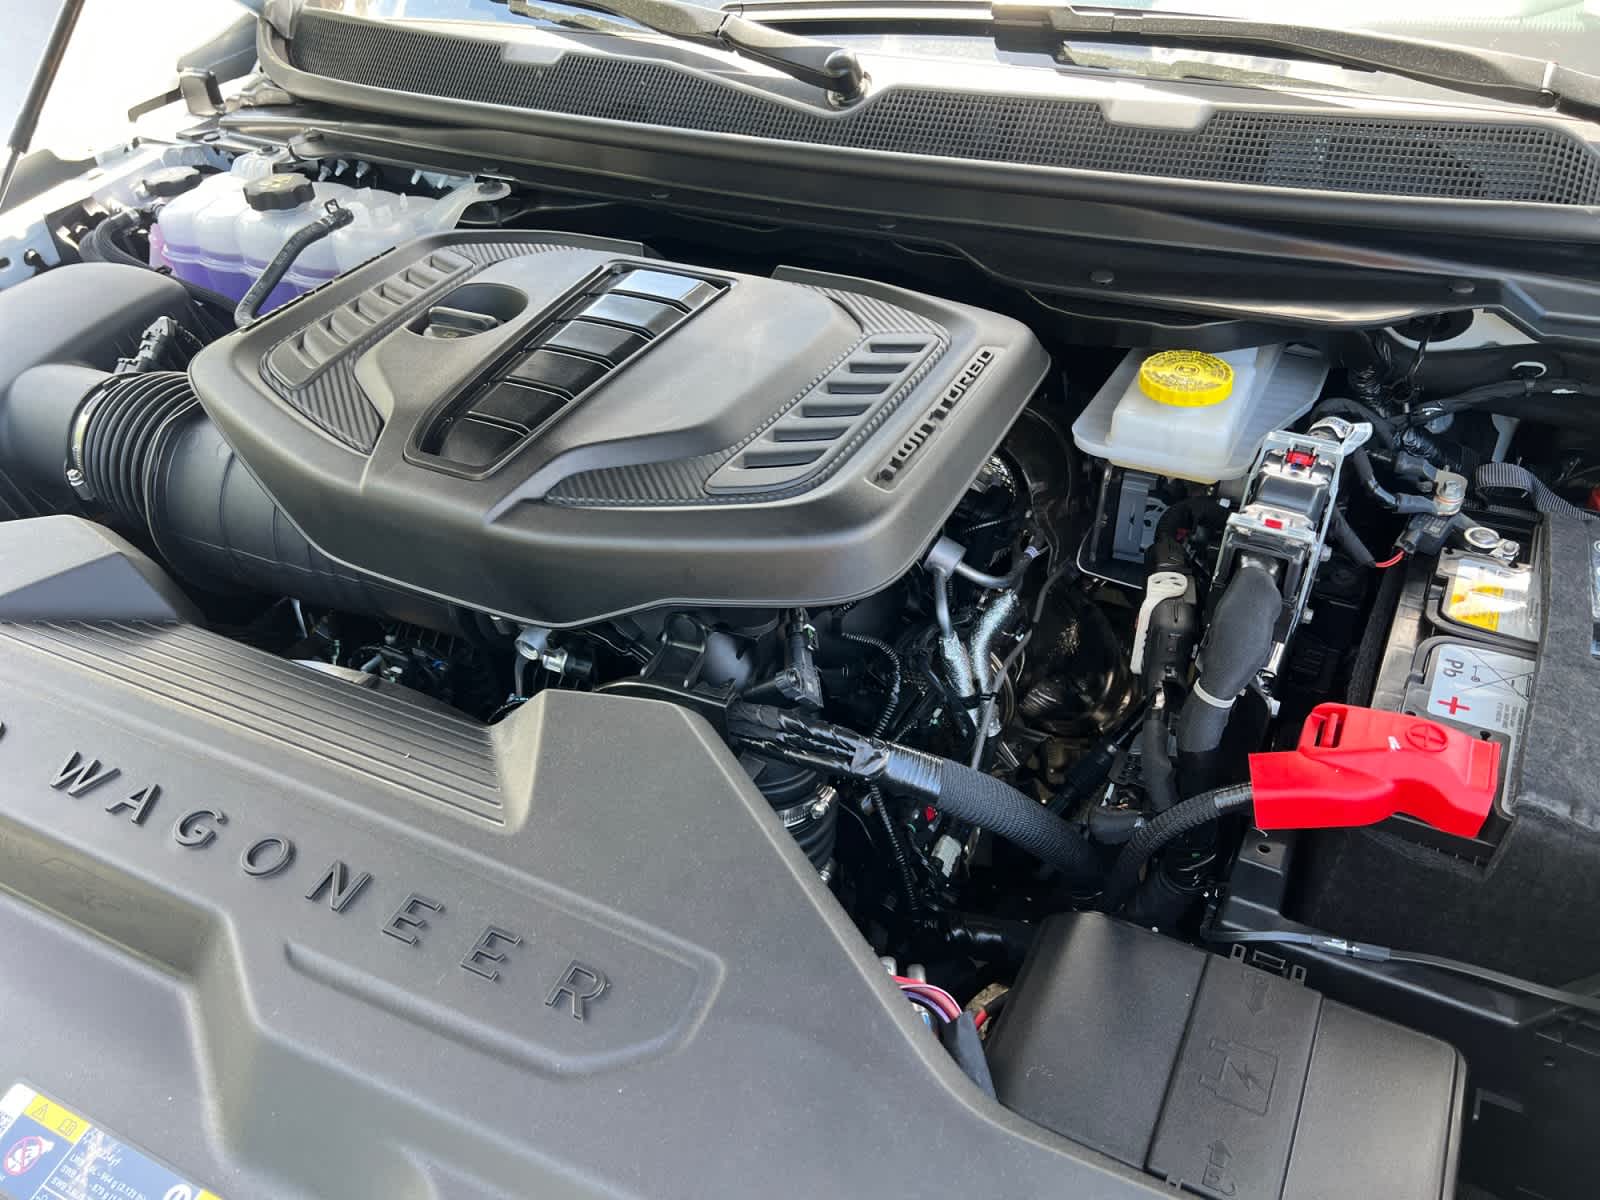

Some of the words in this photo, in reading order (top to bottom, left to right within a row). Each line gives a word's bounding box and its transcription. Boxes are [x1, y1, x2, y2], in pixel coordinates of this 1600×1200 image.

[873, 417, 936, 482] TWIN
[928, 349, 994, 421] TURBO
[1442, 657, 1465, 678] Pb
[49, 750, 612, 1021] WAGONEER
